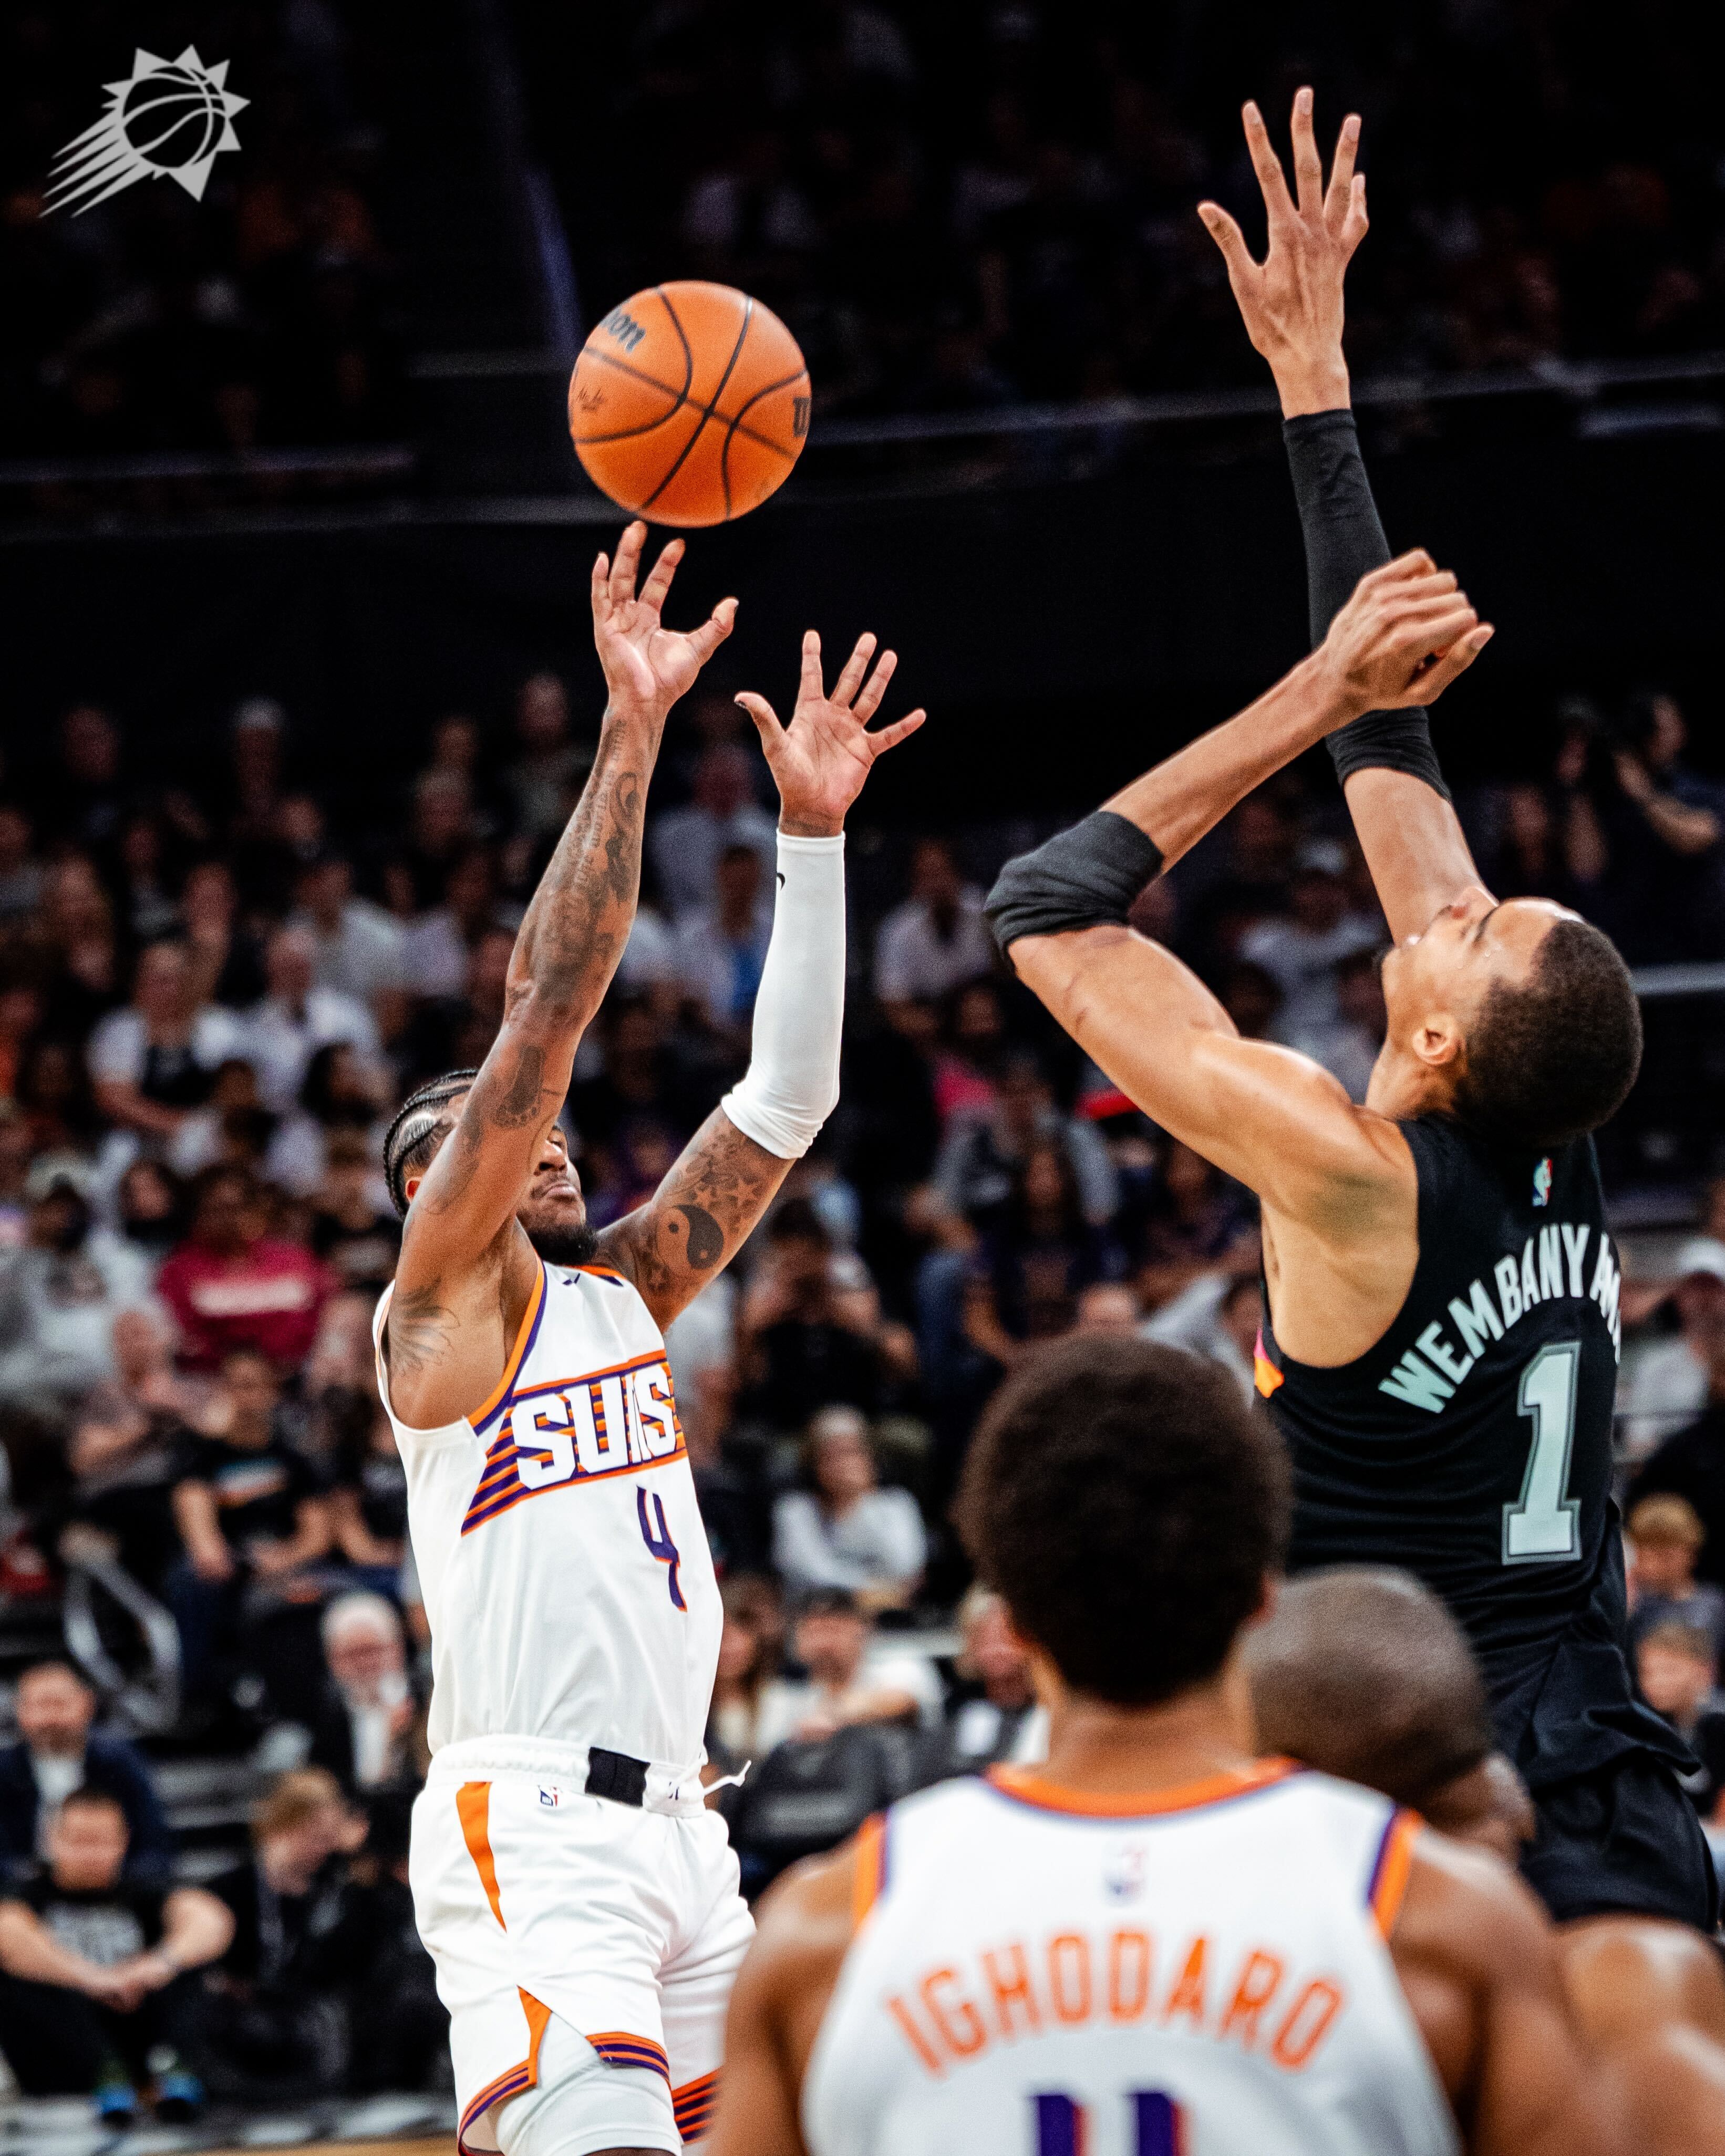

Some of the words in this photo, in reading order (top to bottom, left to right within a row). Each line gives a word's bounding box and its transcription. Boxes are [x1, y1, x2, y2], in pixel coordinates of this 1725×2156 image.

[601, 306, 646, 353] on
[1502, 1340, 1582, 1566] 1
[636, 1485, 688, 1612] 4
[889, 1928, 1343, 2078] IGHODARO
